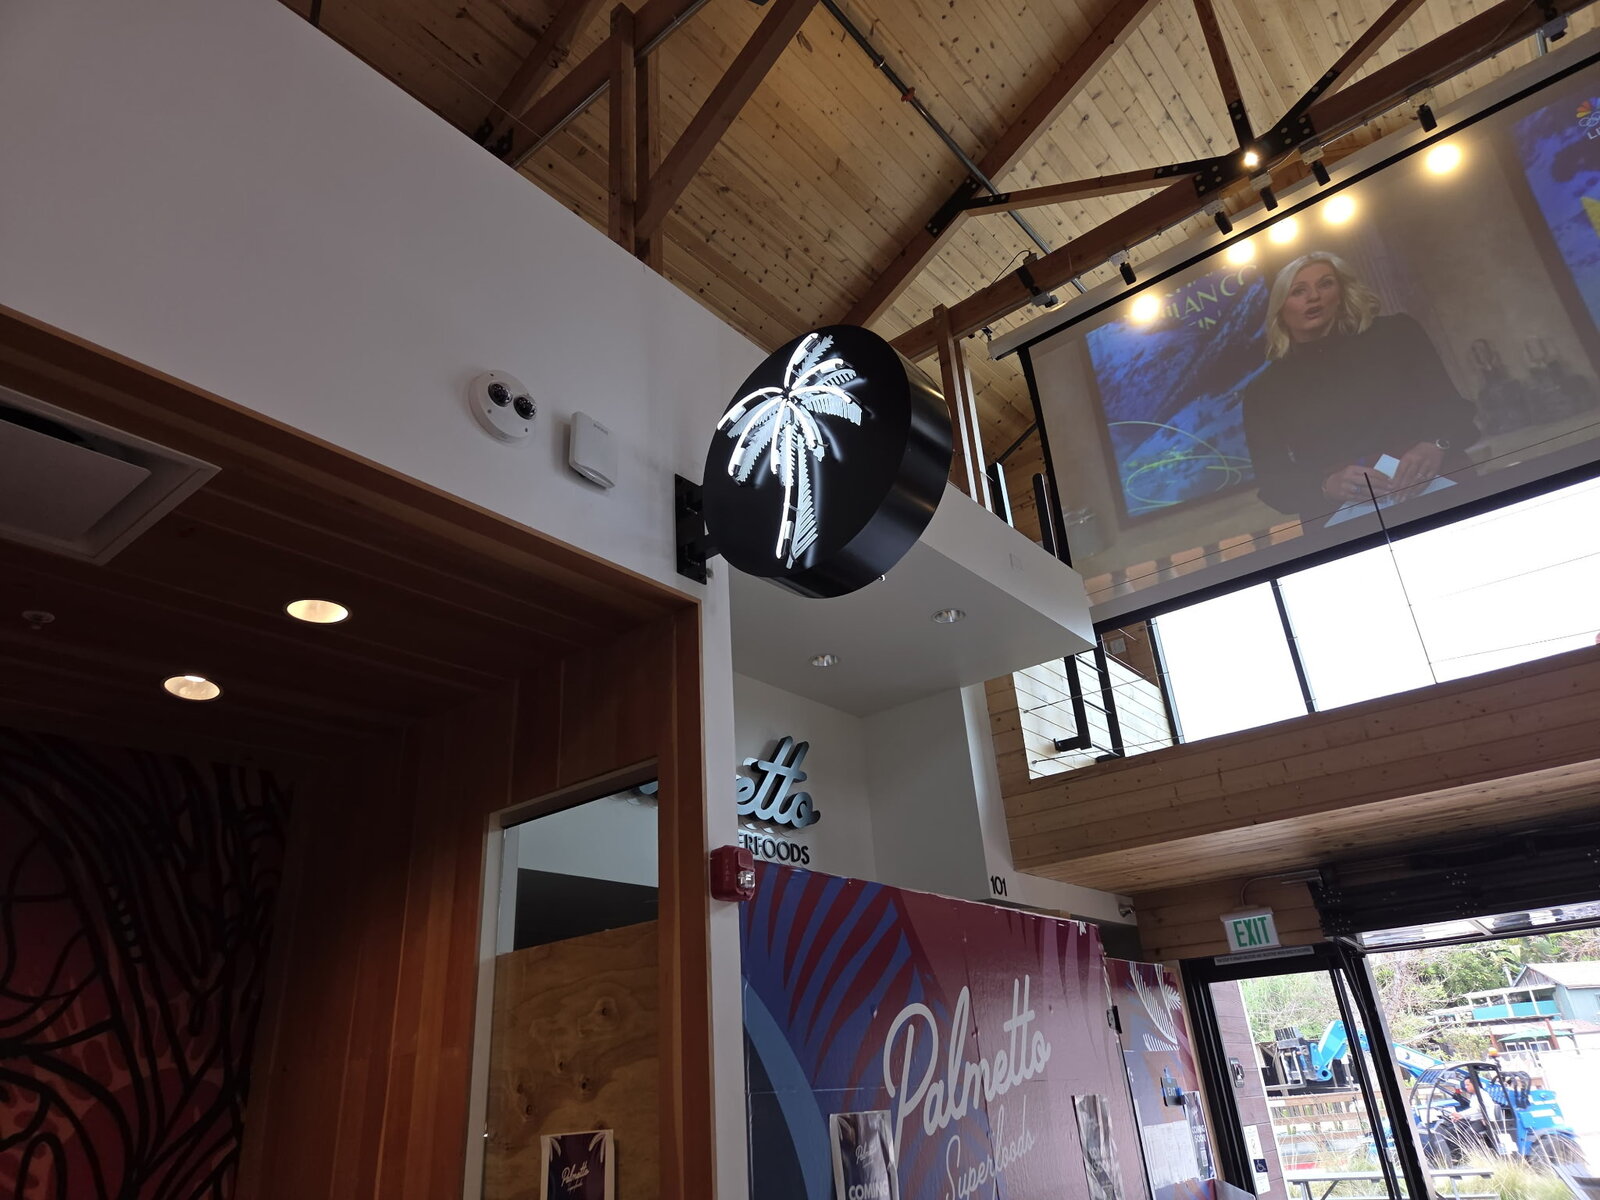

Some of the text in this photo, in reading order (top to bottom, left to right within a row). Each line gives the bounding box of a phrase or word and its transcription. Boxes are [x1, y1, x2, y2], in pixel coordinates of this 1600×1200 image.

[990, 875, 1007, 897] 101
[1232, 916, 1270, 948] EXIT
[883, 975, 1052, 1169] Palmetto
[945, 1093, 1036, 1200] Superfoods
[848, 1181, 890, 1200] COMING
